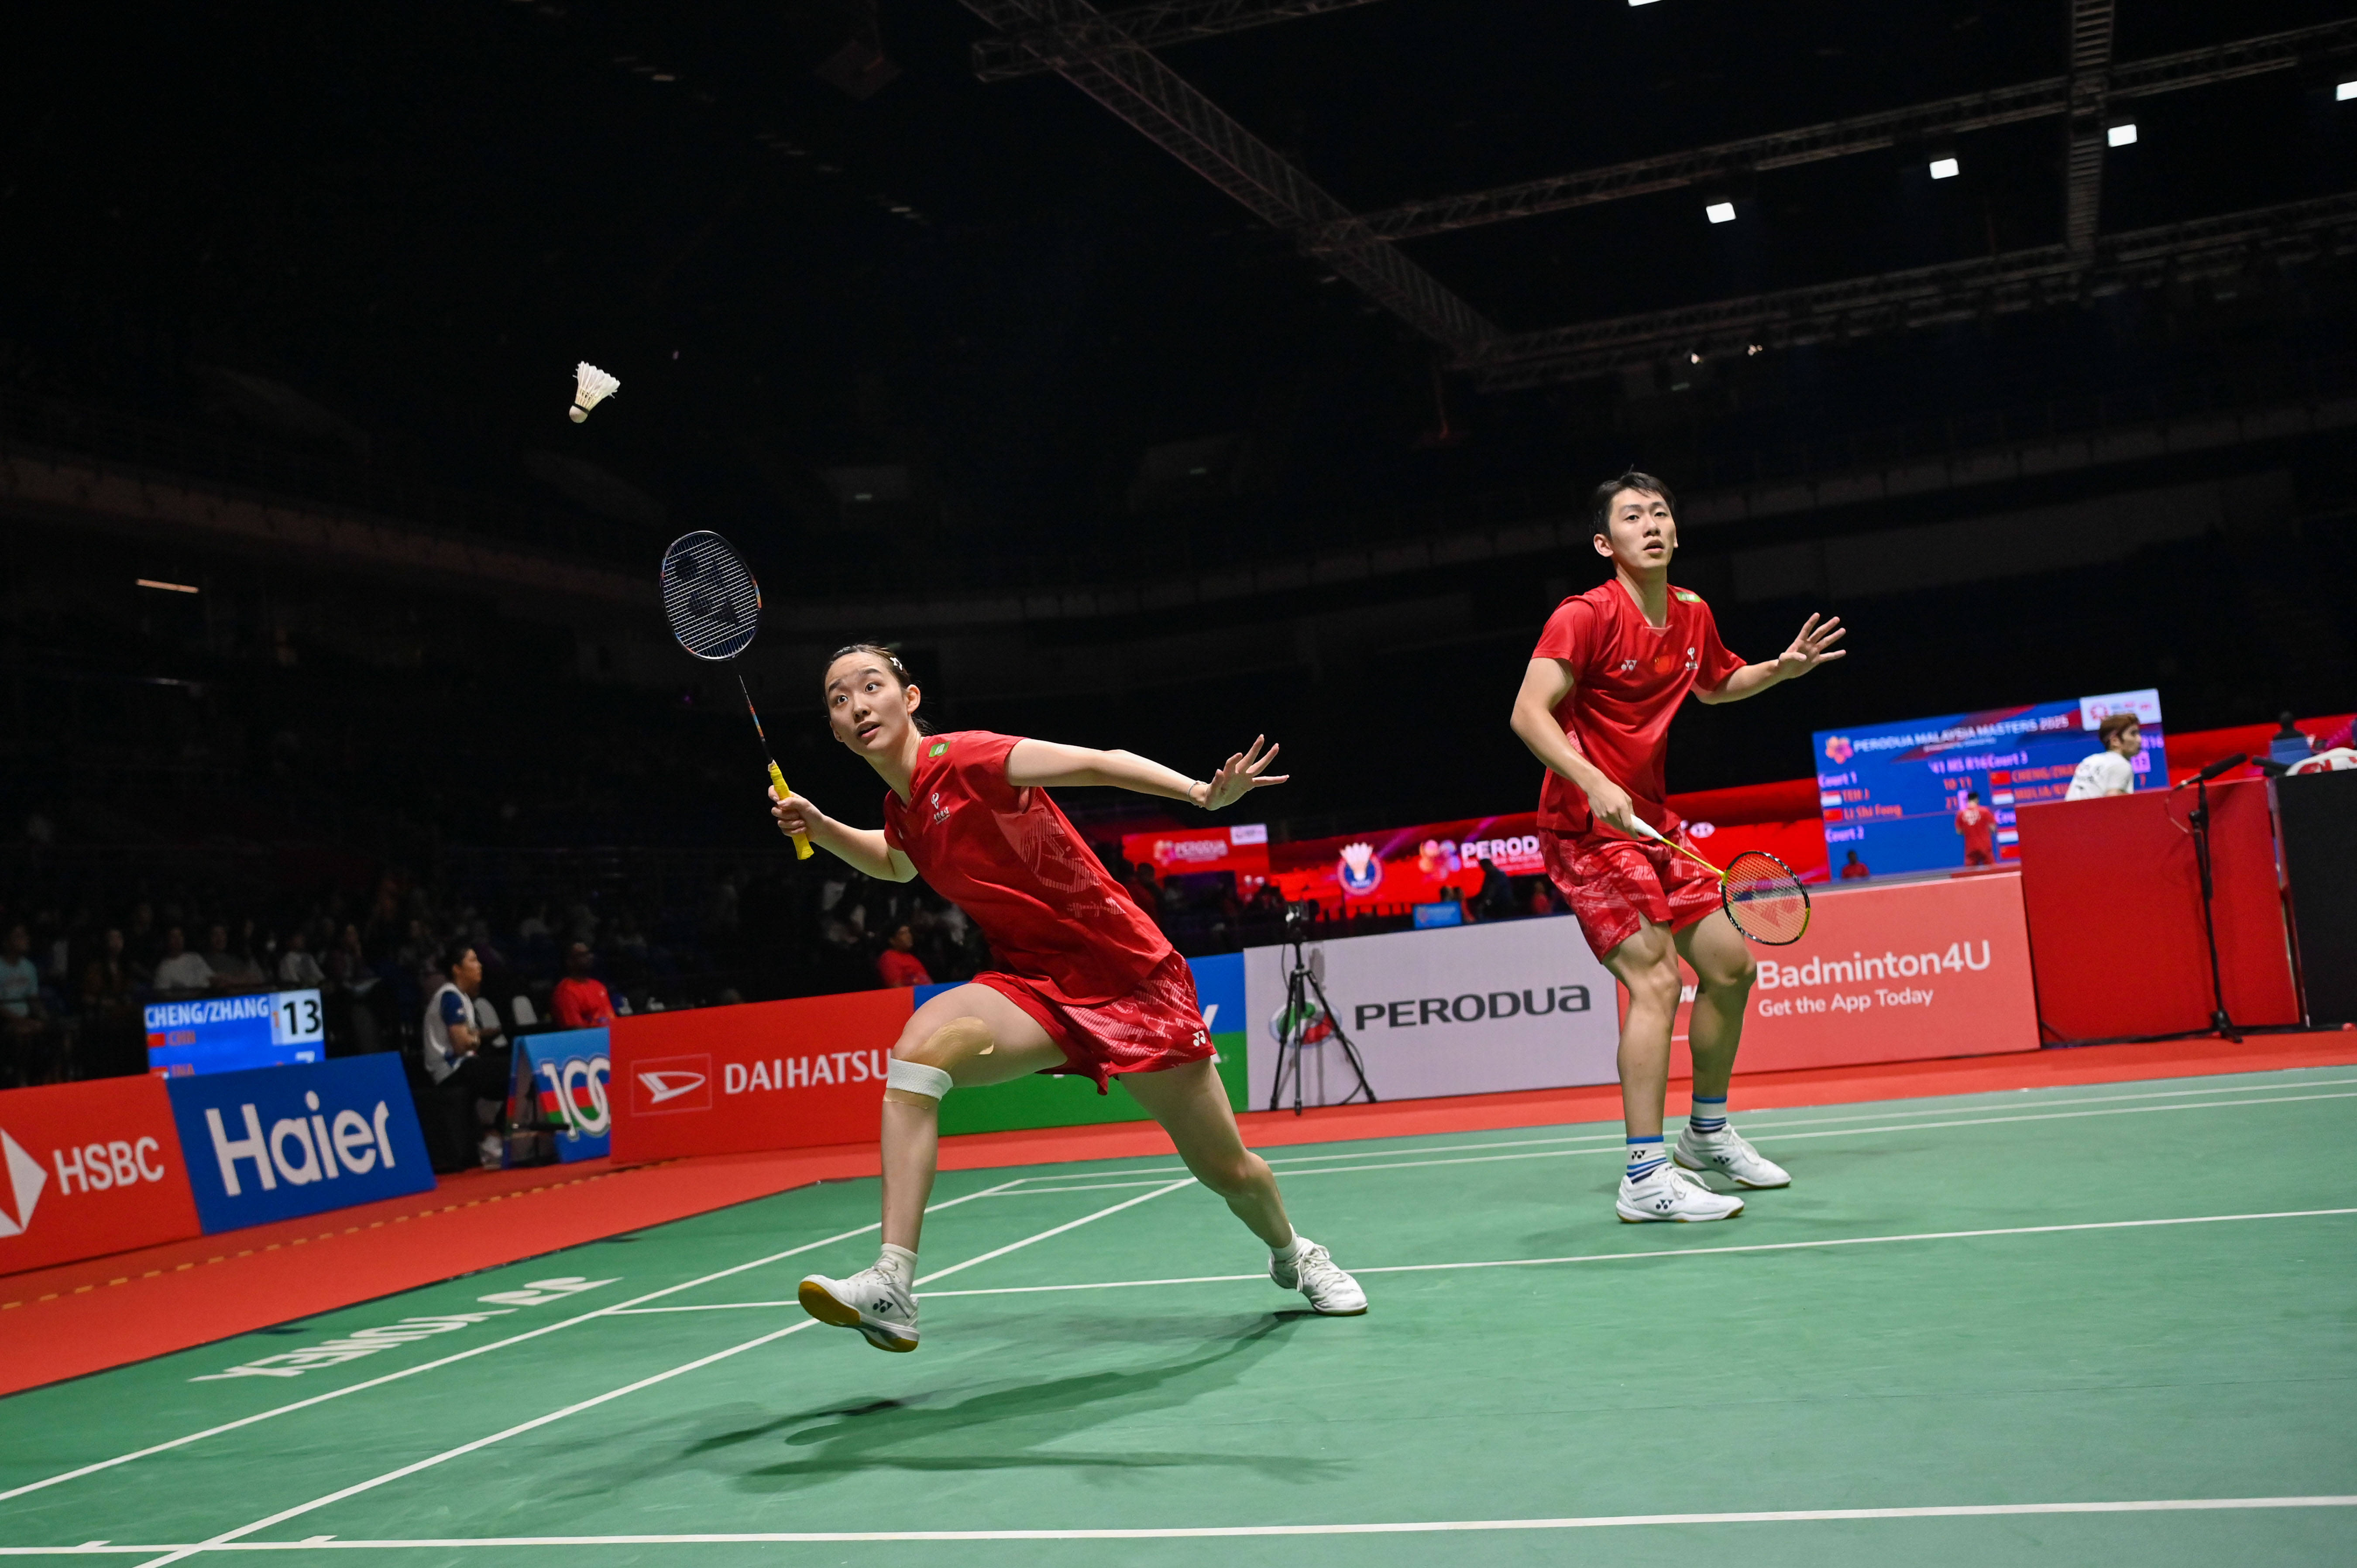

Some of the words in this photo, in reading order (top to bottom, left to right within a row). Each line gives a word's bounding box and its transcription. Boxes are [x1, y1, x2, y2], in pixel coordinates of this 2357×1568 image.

[1976, 719, 2038, 737] MASTERS
[2039, 714, 2069, 730] 2025
[1818, 772, 1849, 788] Court
[1461, 835, 1539, 861] PEROD
[1825, 828, 1855, 842] Court
[1757, 940, 1990, 991] Badminton4U
[145, 998, 269, 1028] CHENG/ZHANG
[283, 999, 321, 1035] 13
[1758, 998, 1791, 1017] Get
[1796, 995, 1827, 1013] the
[1831, 992, 1871, 1012] App
[1874, 988, 1934, 1007] Today
[725, 1049, 891, 1094] DAIHATSU
[205, 1091, 395, 1197] Haier
[54, 1136, 165, 1195] HSBC
